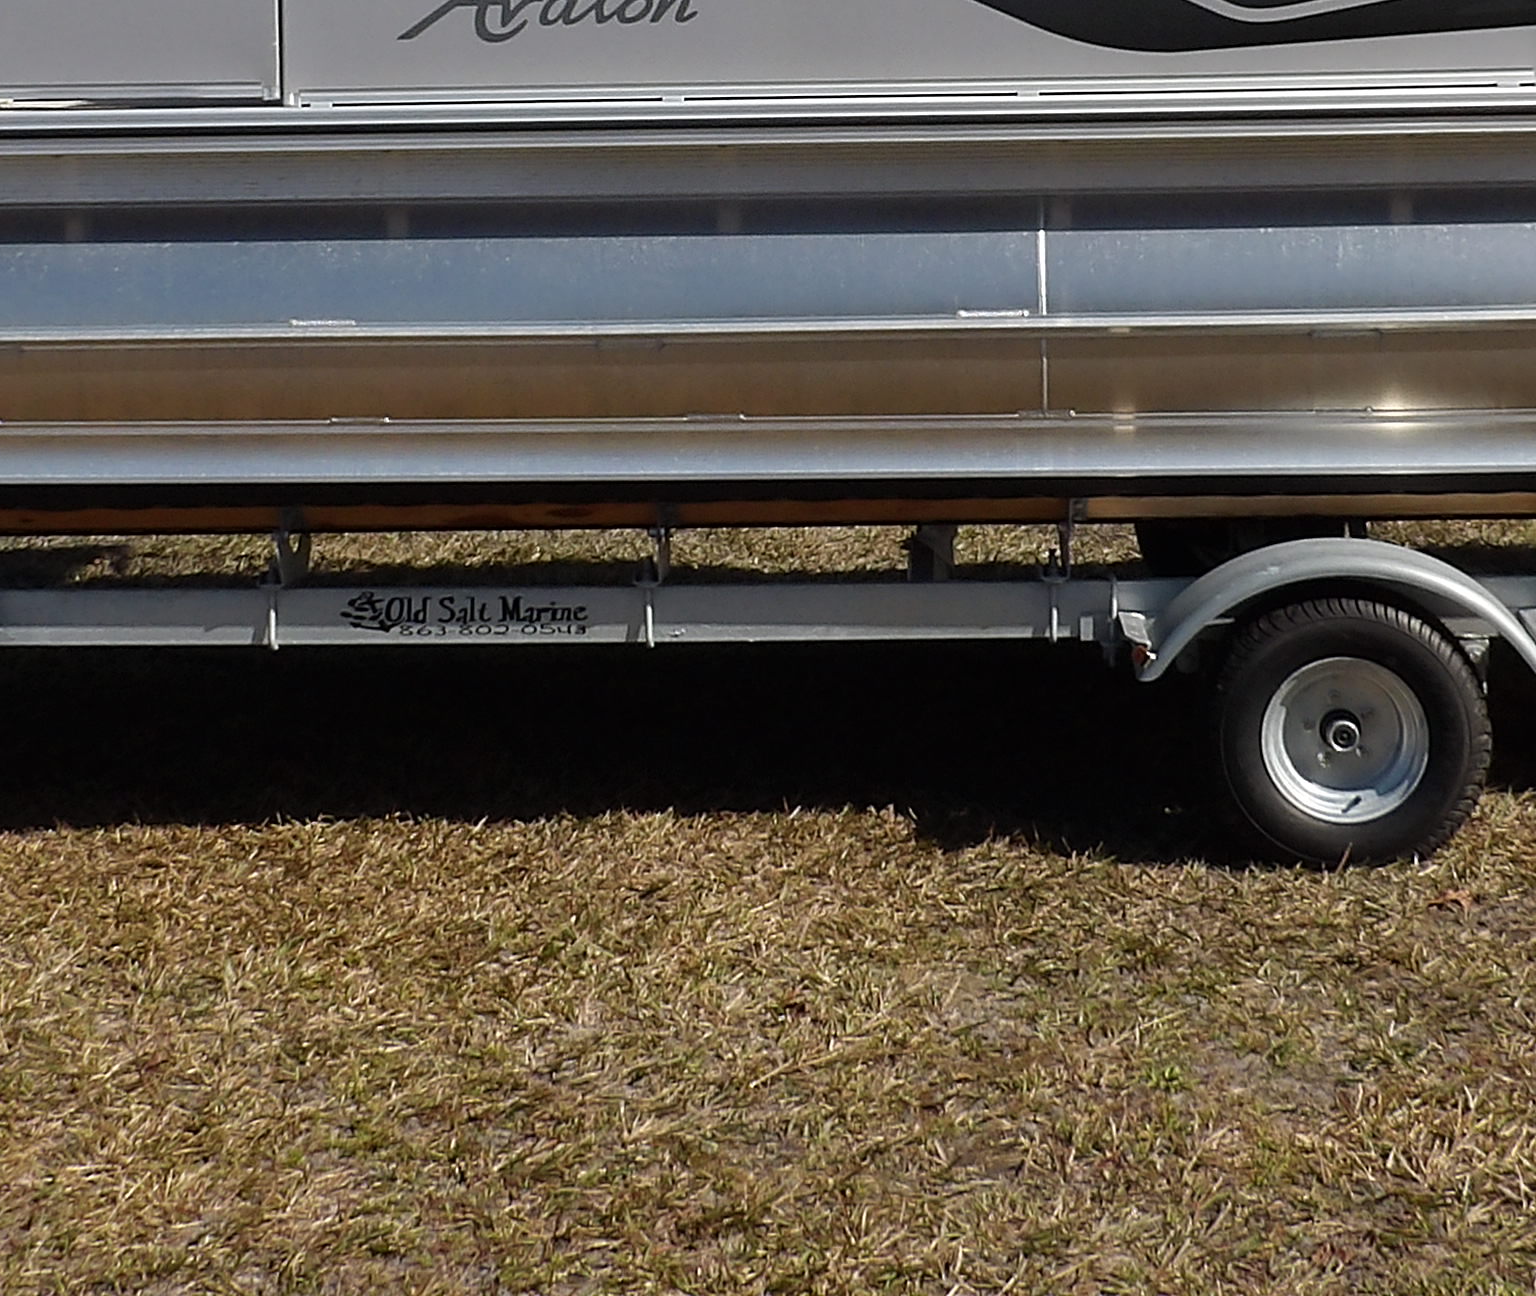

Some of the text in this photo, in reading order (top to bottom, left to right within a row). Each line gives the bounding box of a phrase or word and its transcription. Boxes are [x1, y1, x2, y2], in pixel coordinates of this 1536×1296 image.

[384, 595, 589, 625] Old Salt Marine
